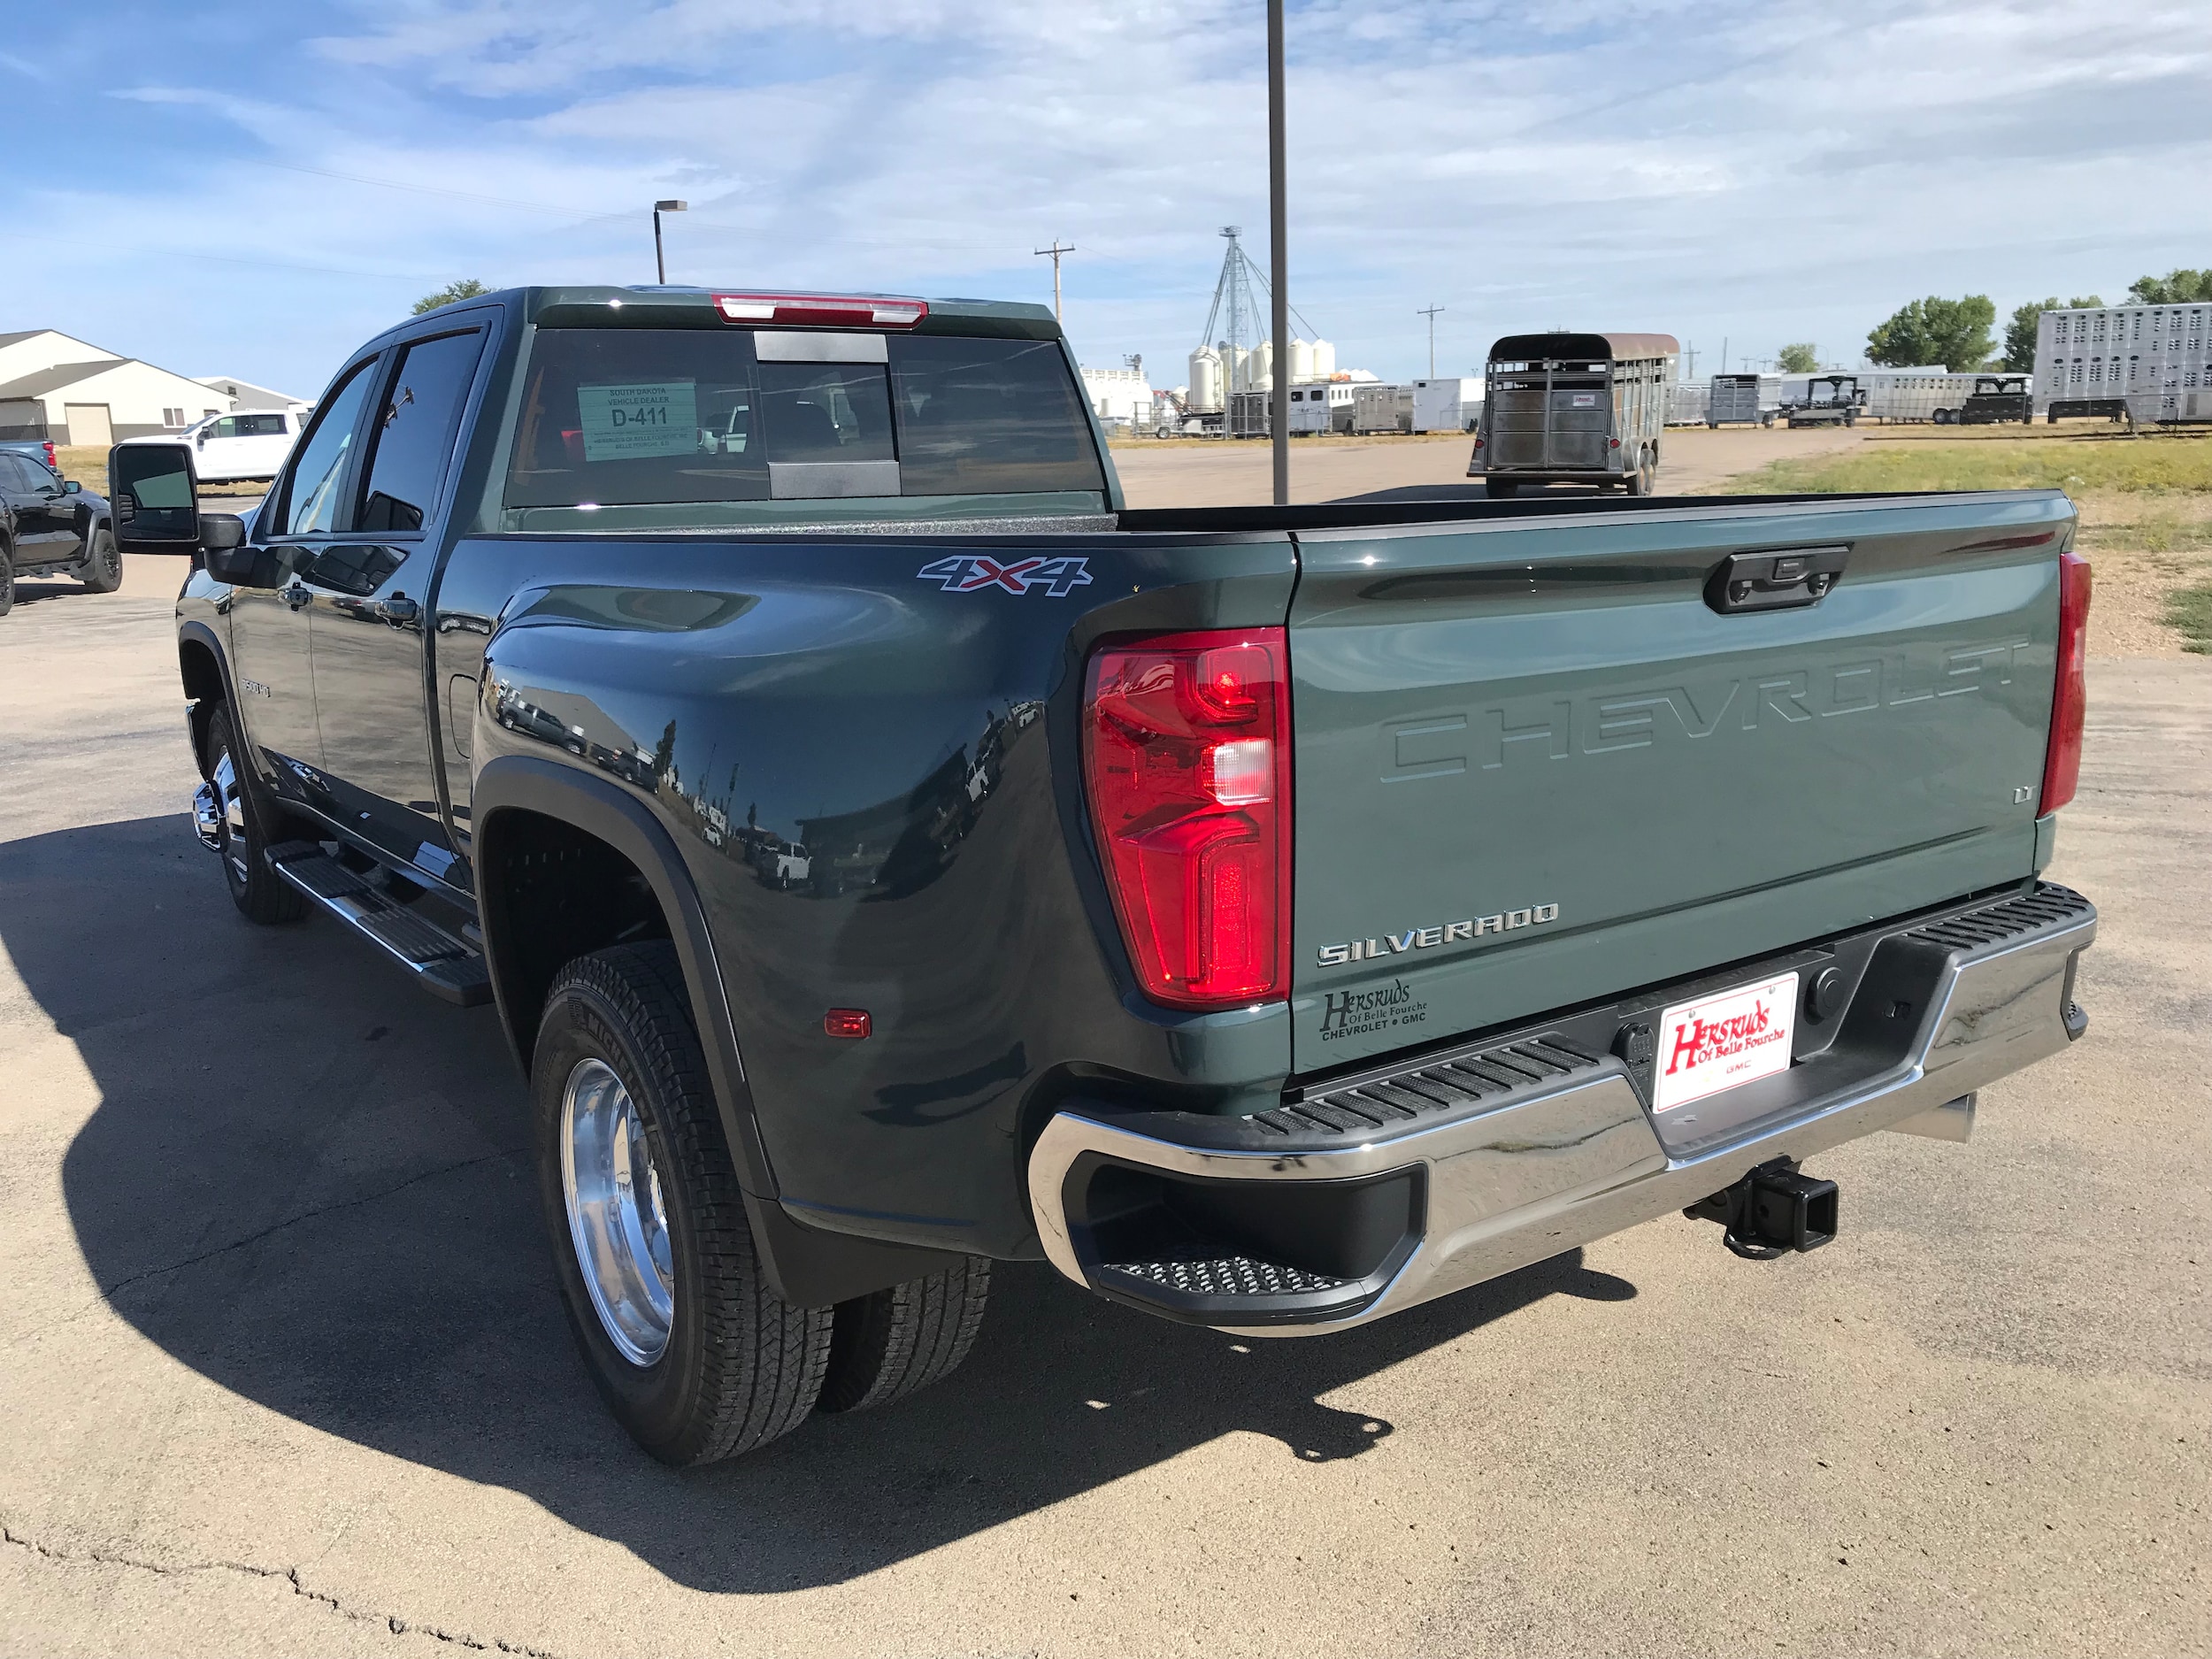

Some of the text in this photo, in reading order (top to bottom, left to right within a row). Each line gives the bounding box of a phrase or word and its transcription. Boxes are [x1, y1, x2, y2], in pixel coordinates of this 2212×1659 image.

[608, 397, 638, 406] VEHICLE
[611, 406, 667, 427] D-411
[916, 555, 1094, 597] 4X4
[1379, 639, 2031, 784] CHEVROLET
[2013, 785, 2038, 805] LT
[1317, 902, 1559, 969] SILVERADO
[1348, 1001, 1428, 1025] Of Belle Fourche
[1322, 1012, 1426, 1041] CHEVROLET GMC
[1697, 1028, 1786, 1064] Of Belle Fourche
[1726, 1060, 1752, 1074] GMC
